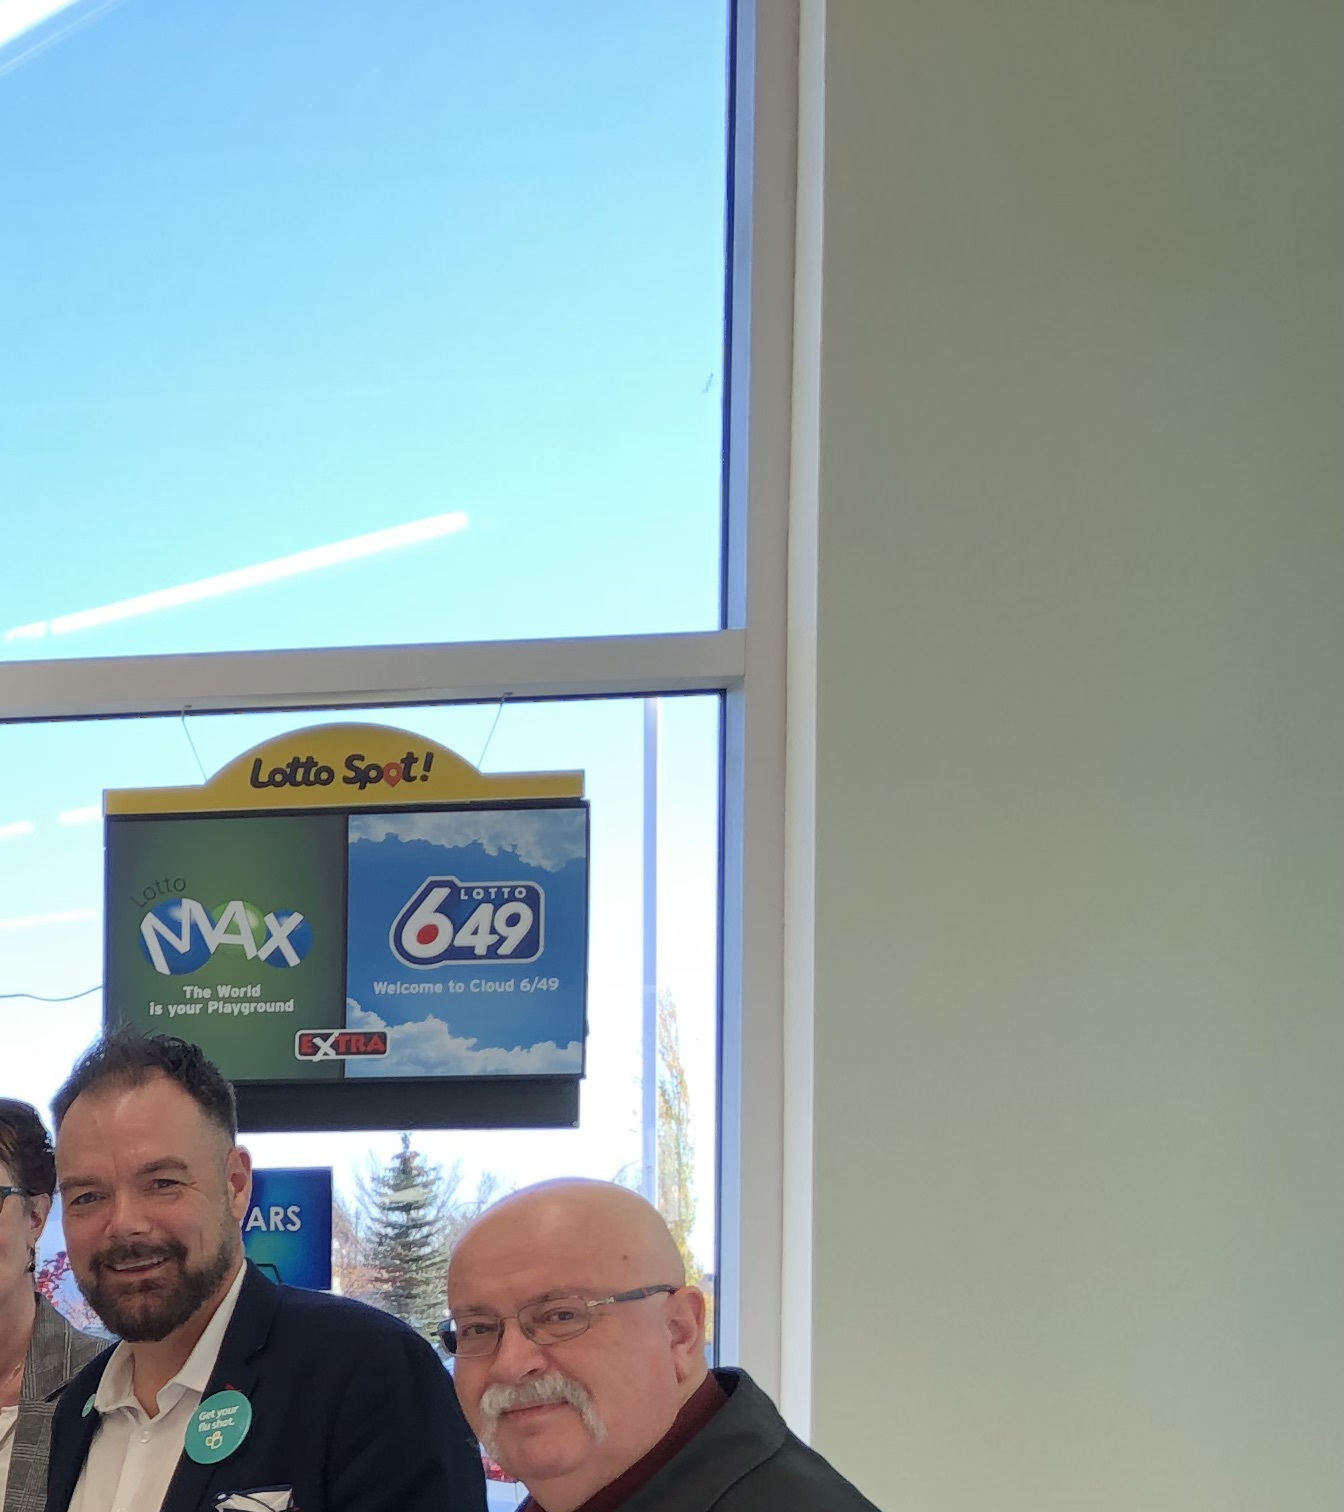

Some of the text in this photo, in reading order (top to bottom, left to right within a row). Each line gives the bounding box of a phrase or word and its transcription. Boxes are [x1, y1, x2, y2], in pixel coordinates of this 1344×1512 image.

[250, 752, 434, 790] Lotto Spot!
[460, 887, 527, 900] LOTTO
[140, 898, 305, 976] MAX
[183, 984, 262, 999] The World
[373, 977, 560, 996] Welcome to Cloud 6/49
[168, 1003, 204, 1018] your
[207, 999, 295, 1016] Playground
[299, 1032, 387, 1061] EXTRA
[244, 1205, 302, 1232] ARS
[198, 1405, 240, 1421] Get your
